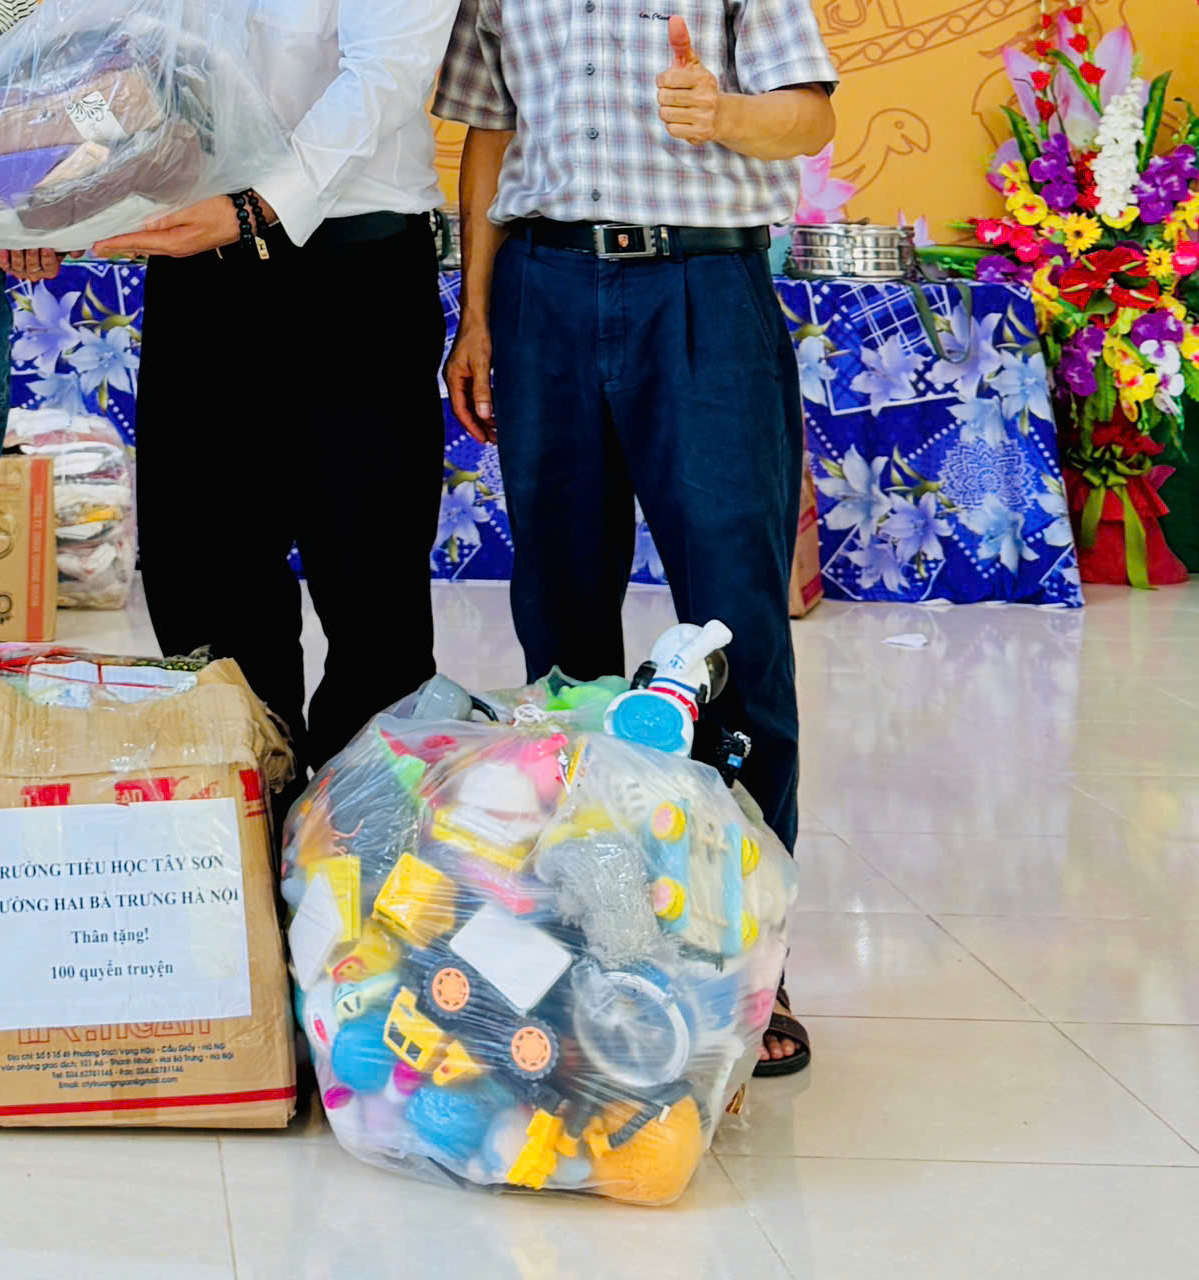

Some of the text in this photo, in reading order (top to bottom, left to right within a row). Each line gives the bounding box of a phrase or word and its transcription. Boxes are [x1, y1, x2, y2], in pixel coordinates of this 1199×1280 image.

[110, 858, 148, 875] HỌC
[151, 854, 187, 871] TÂY
[191, 854, 225, 870] SƠN
[54, 895, 85, 911] HAI
[90, 890, 112, 910] BÀ
[115, 890, 177, 908] TRƯNG
[181, 886, 206, 905] HÀ
[210, 886, 239, 905] NỘI
[70, 927, 150, 945] Thân tặng!
[51, 965, 76, 980] 100
[127, 959, 174, 979] truyện
